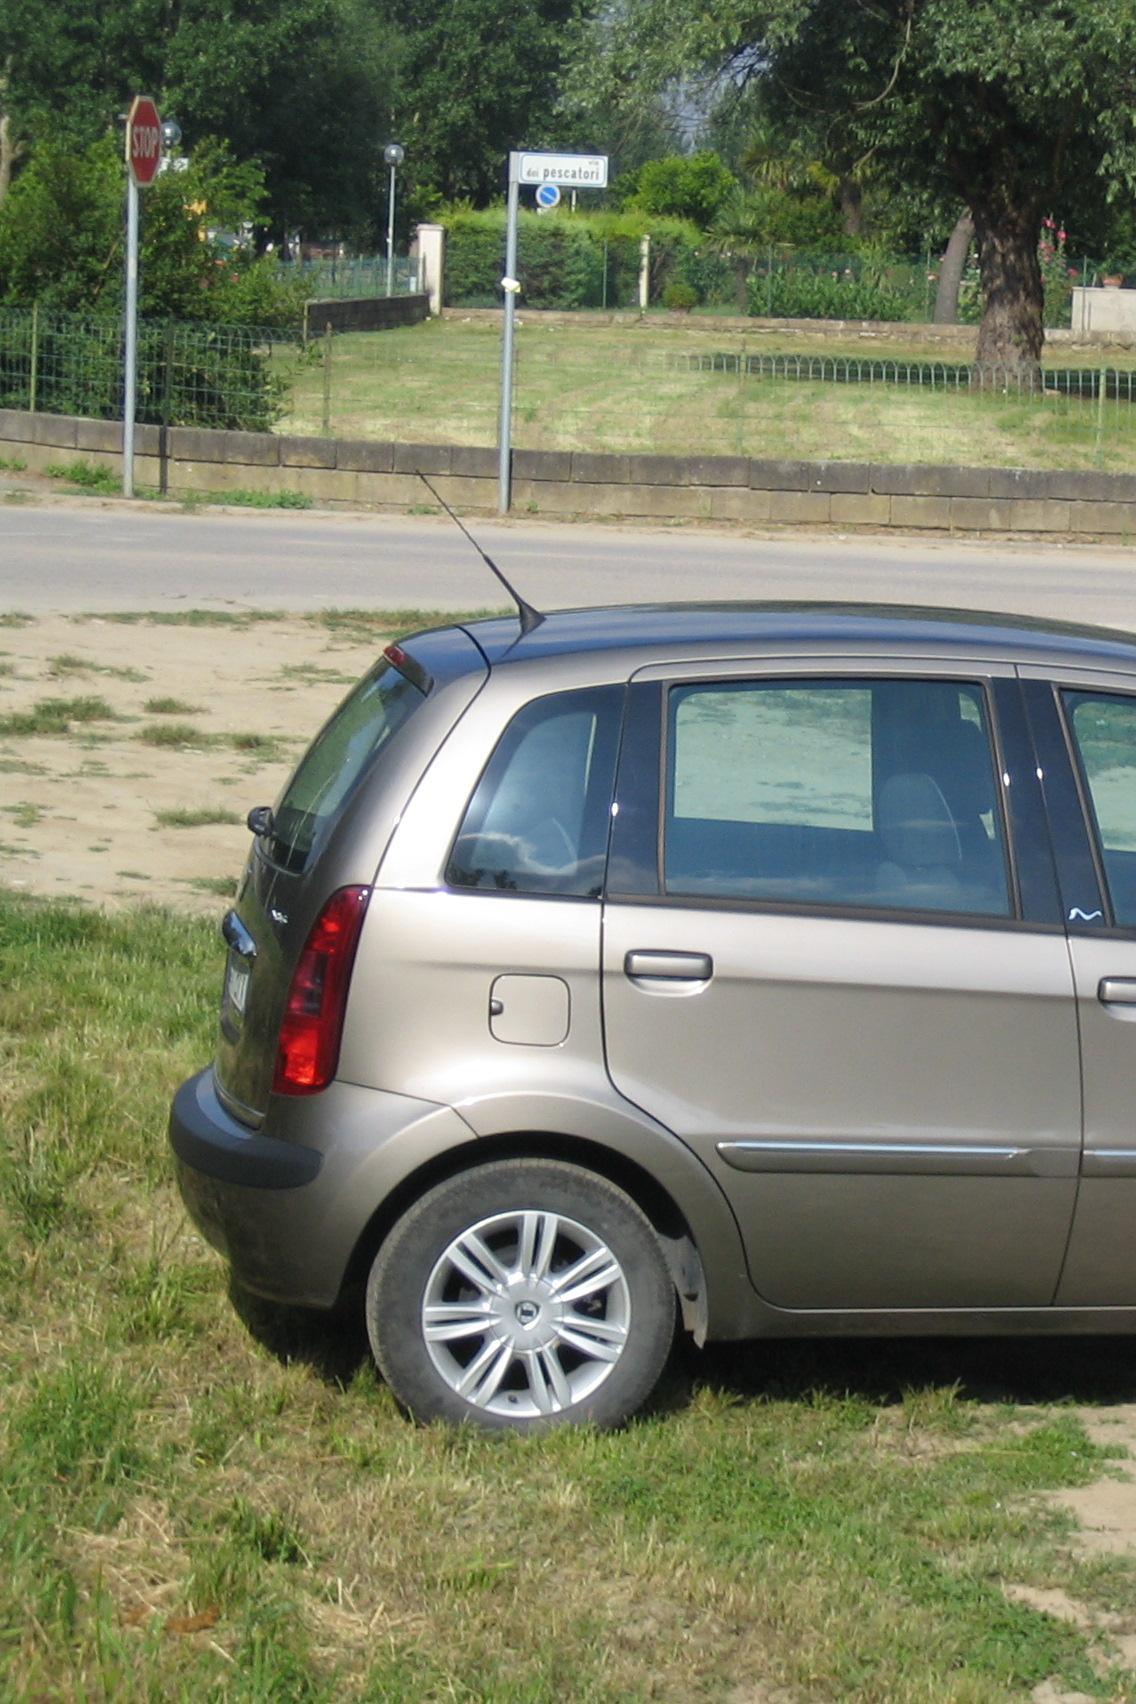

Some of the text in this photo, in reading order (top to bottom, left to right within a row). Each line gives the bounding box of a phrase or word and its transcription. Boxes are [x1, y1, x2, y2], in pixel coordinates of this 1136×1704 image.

[132, 126, 159, 158] STOP
[526, 166, 600, 180] dei pescatori
